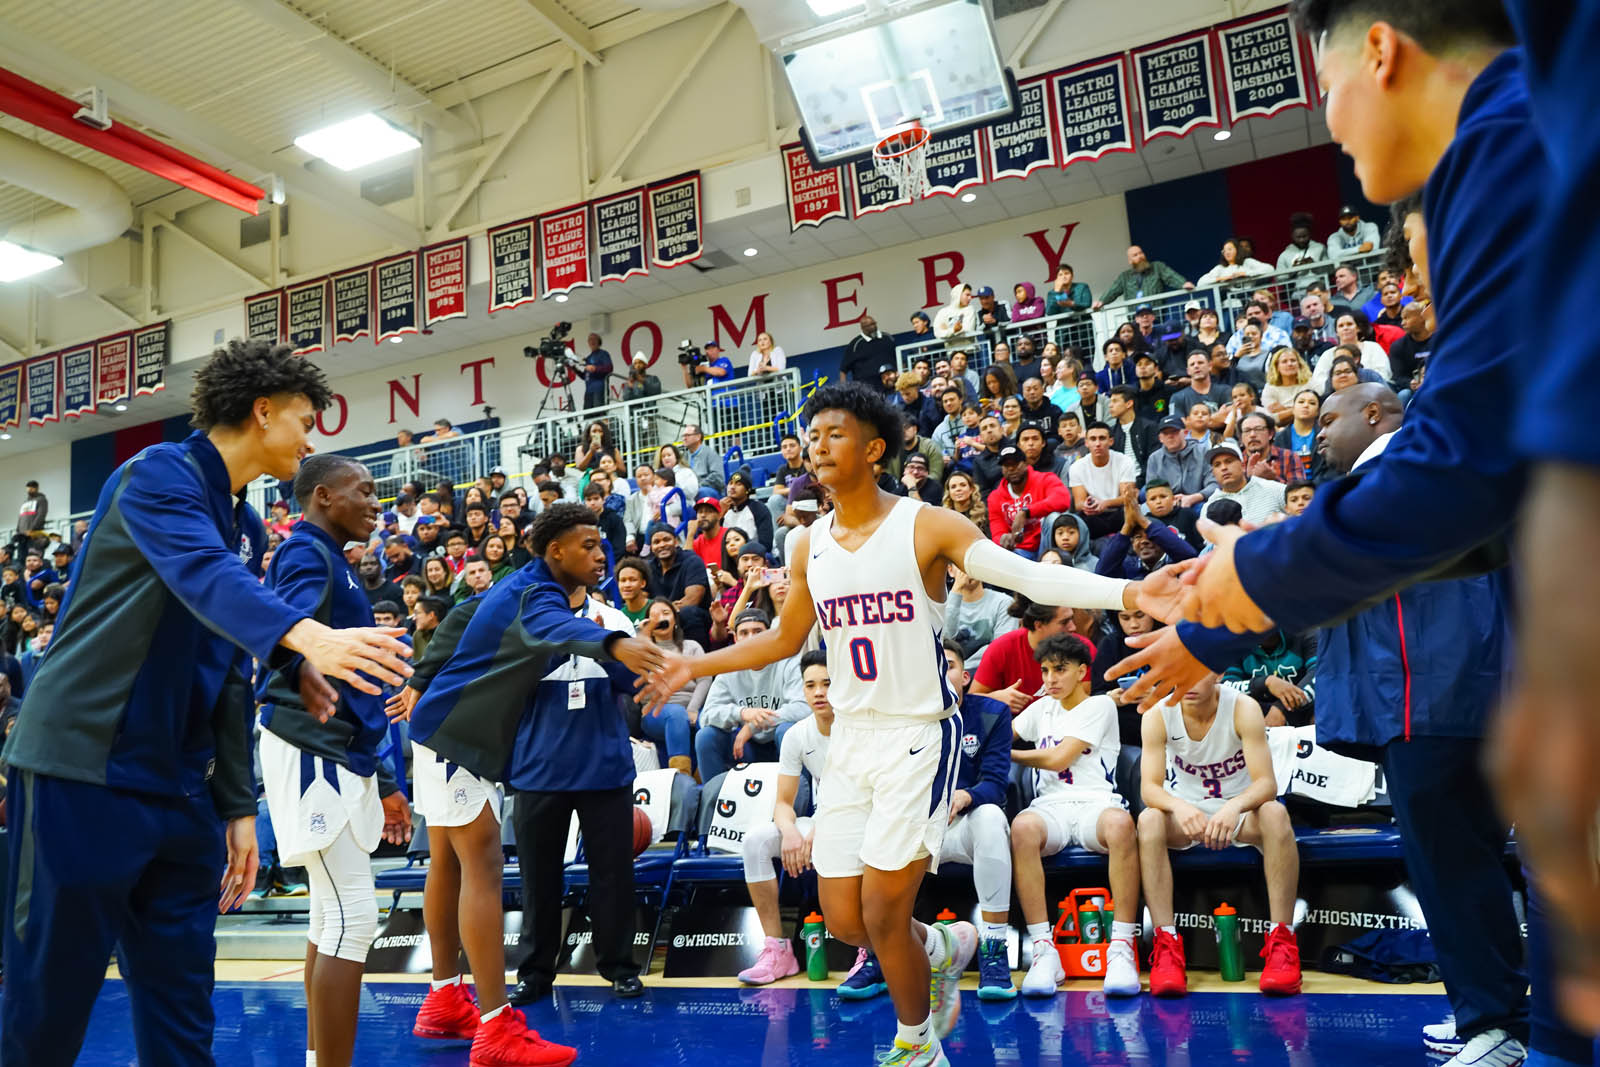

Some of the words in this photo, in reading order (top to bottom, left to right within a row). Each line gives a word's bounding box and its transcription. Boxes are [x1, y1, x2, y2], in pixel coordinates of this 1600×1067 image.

[1230, 23, 1285, 49] METRO
[1147, 46, 1198, 70] METRO
[1231, 38, 1289, 63] LEAGUE
[1148, 61, 1199, 84] LEAGUE
[1233, 52, 1291, 78] CHAMPS
[1064, 74, 1114, 98] METRO
[1150, 75, 1201, 97] CHAMPS
[1233, 66, 1296, 92] BASEBALL
[1065, 88, 1115, 111] LEAGUE
[1149, 88, 1206, 111] BASKETBALL
[1249, 83, 1284, 101] 2000
[1067, 102, 1117, 124] CHAMPS
[1163, 104, 1194, 121] 2000
[995, 115, 1042, 137] CHAMPS
[1066, 115, 1122, 137] BASEBALL
[926, 134, 972, 156] CHAMPS
[993, 127, 1048, 149] SWIMMING
[926, 148, 976, 168] BASEBALL
[1009, 142, 1034, 158] 1997
[937, 163, 965, 178] 1997
[794, 172, 835, 192] CHAMPS
[656, 186, 692, 206] METRO
[793, 185, 838, 204] BASKETBALL
[601, 200, 637, 219] METRO
[804, 199, 828, 213] 1997
[546, 215, 582, 234] METRO
[601, 213, 637, 231] LEAGUE
[658, 209, 693, 228] CHAMPS
[495, 229, 528, 247] METRO
[547, 228, 582, 246] LEAGUE
[602, 225, 638, 244] CHAMPS
[665, 223, 688, 236] BOYS
[496, 240, 528, 257] LEAGUE
[558, 240, 583, 254] CHAMPS
[600, 237, 640, 254] BASKETBALL
[658, 231, 697, 249] SWIMMING
[430, 248, 460, 265] METRO
[504, 252, 521, 264] AND
[381, 262, 412, 279] METRO
[430, 260, 461, 277] LEAGUE
[336, 275, 366, 291] METRO
[382, 273, 412, 289] LEAGUE
[430, 273, 461, 289] CHAMPS
[497, 277, 529, 294] CHAMPS
[292, 288, 321, 304] METRO
[337, 286, 366, 301] LEAGUE
[382, 284, 412, 300] CHAMPS
[250, 299, 277, 315] METRO
[292, 299, 321, 315] LEAGUE
[292, 309, 321, 325] CHAMPS
[139, 331, 165, 346] METRO
[817, 590, 914, 630] AZTECS
[850, 636, 878, 681] 0
[1202, 779, 1222, 799] 3
[1304, 910, 1420, 930] WHOSNEXTHS
[1081, 949, 1102, 973] G
